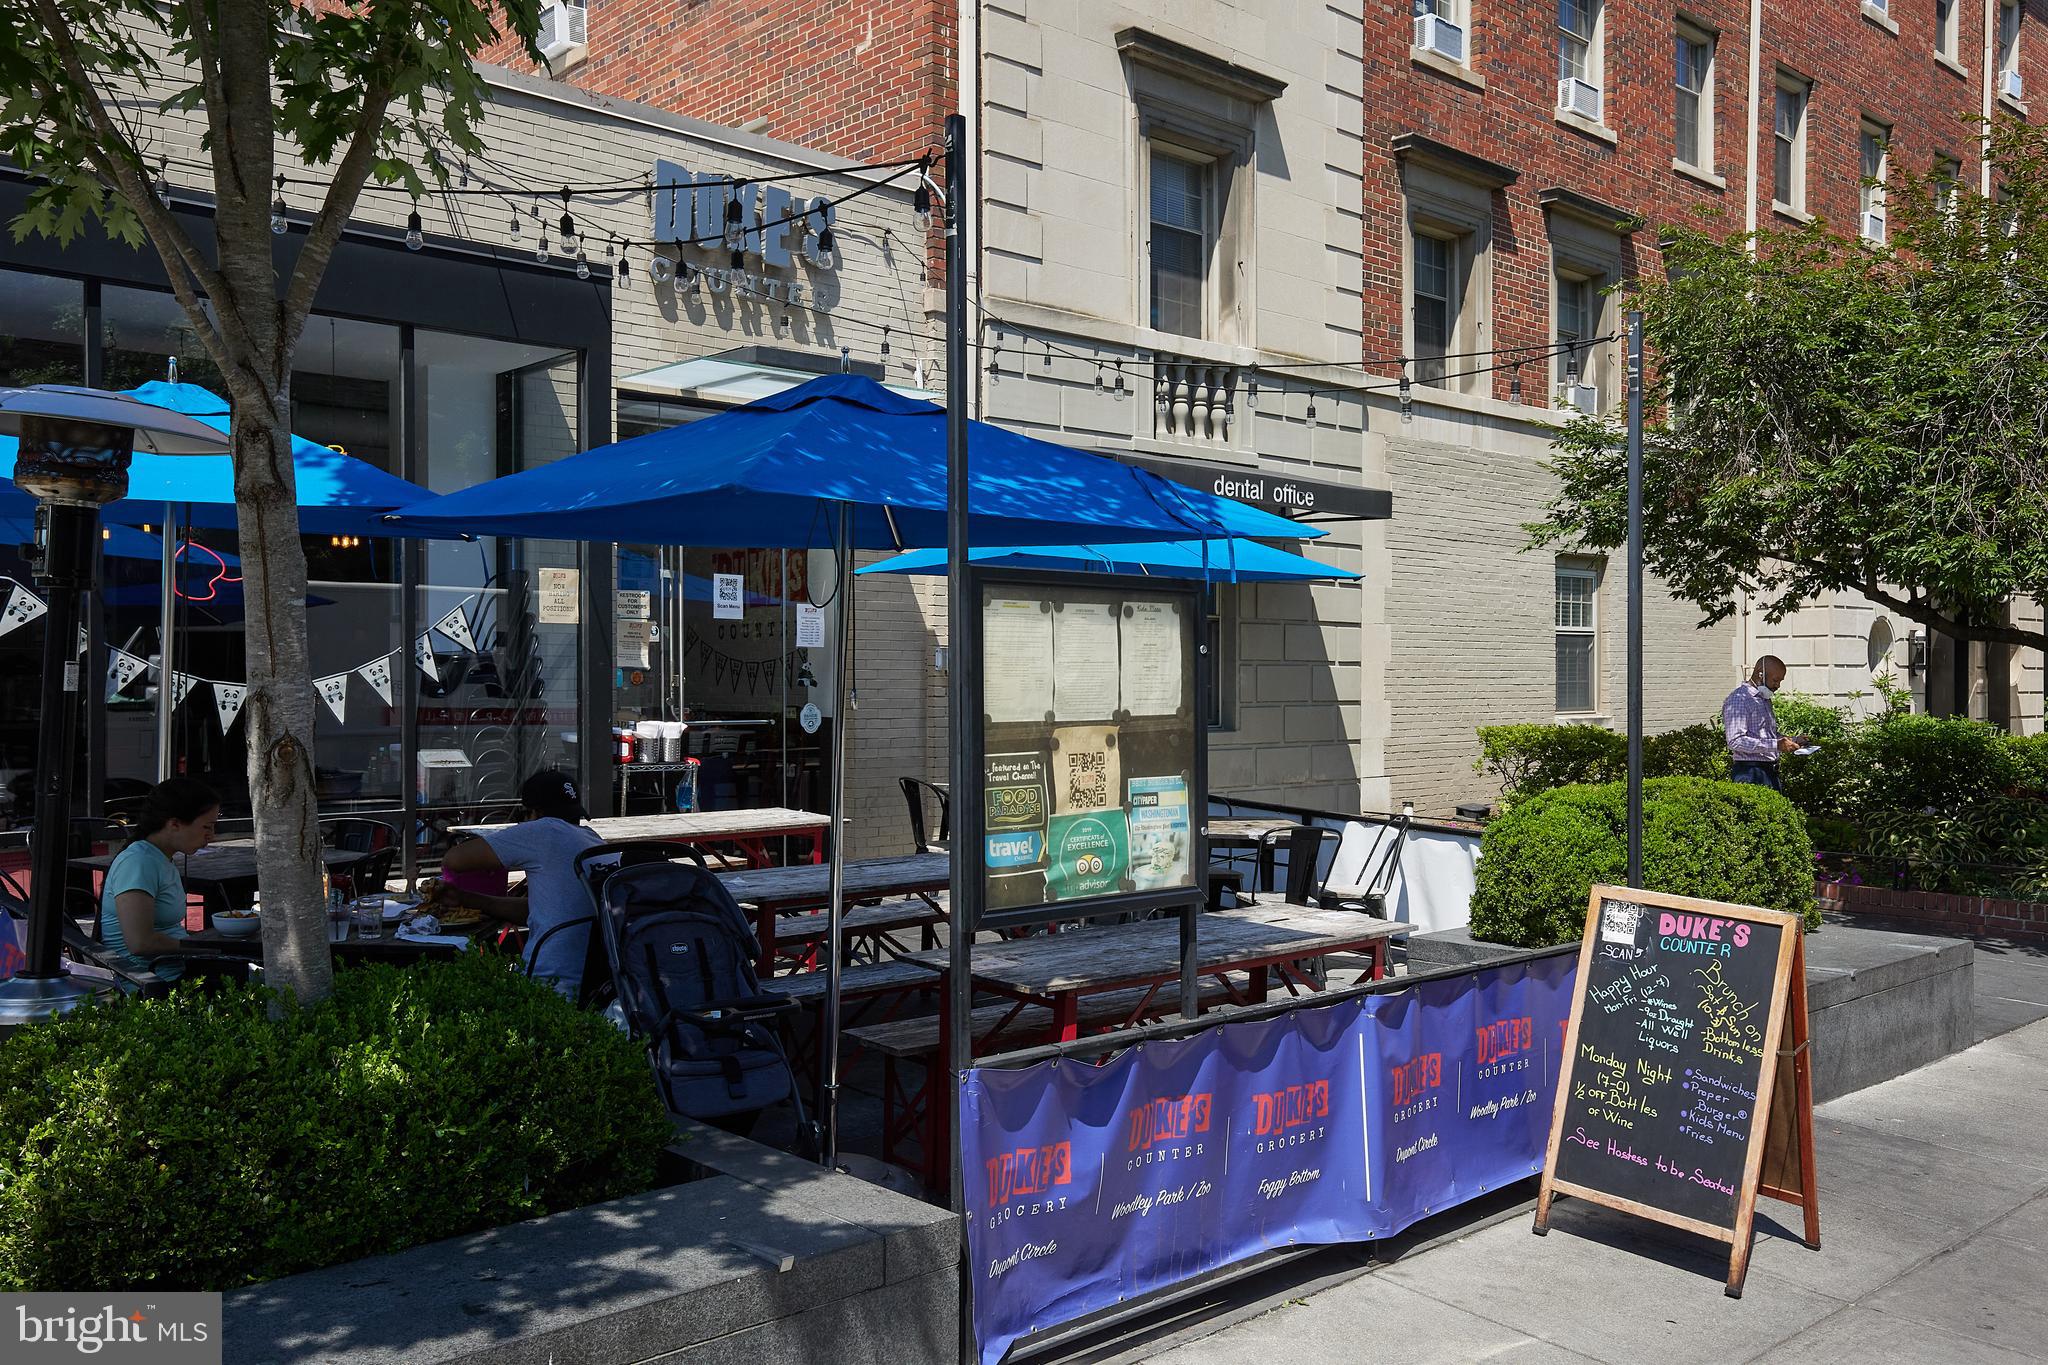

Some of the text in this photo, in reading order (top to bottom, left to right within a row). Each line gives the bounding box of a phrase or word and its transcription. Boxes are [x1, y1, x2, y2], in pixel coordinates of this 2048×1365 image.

[652, 159, 836, 270] DUKE'S
[1214, 475, 1314, 507] dental office
[987, 772, 1009, 782] Travel
[990, 802, 1041, 817] PARADISE
[992, 788, 1037, 806] FOOD
[989, 835, 1033, 857] travel
[1067, 840, 1109, 852] EXCELLENCE
[1070, 834, 1100, 843] CERTIFICATE
[1658, 912, 1752, 948] DUKE'S
[1599, 944, 1634, 960] SCAN
[1660, 936, 1731, 958] COUNTER
[1588, 964, 1658, 1004] Happy Hour
[1604, 974, 1670, 1014] Mon-Fri (12-7)
[1694, 958, 1761, 1042] Brunch on
[1697, 984, 1723, 1005] Sat
[1720, 1015, 1741, 1037] Sun
[1475, 1016, 1533, 1065] DUKE'S
[1638, 1030, 1679, 1053] Liquors
[1661, 1024, 1689, 1040] Well
[1581, 1043, 1673, 1085] Monday Night
[1702, 1041, 1744, 1064] Drinks
[1392, 1052, 1442, 1106] DUKE'S
[1478, 1058, 1530, 1080] COUNTER
[1692, 1068, 1757, 1101] Sandwiches
[1252, 1079, 1329, 1136] DUKE'S
[1470, 1099, 1499, 1120] Woodley
[1500, 1091, 1519, 1112] Park
[1526, 1089, 1537, 1103] Zoo
[1690, 1081, 1730, 1103] Proper
[1128, 1093, 1213, 1153] DUKE'S
[1394, 1096, 1439, 1124] GROCERY
[1602, 1108, 1634, 1130] Wine
[1688, 1109, 1745, 1142] Kids Menu
[1256, 1126, 1326, 1154] GROCERY
[1395, 1132, 1439, 1165] Dupont Circle
[1685, 1125, 1714, 1145] Fries
[1127, 1143, 1205, 1172] COUNTER
[1566, 1126, 1736, 1197] See Hostess to be Seated
[986, 1140, 1072, 1209] DUKE'S
[1257, 1167, 1321, 1200] Foggy Bottom
[989, 1196, 1067, 1230] GROCERY
[1111, 1193, 1153, 1221] Woodley
[1155, 1184, 1185, 1207] Park
[1196, 1179, 1212, 1199] Zoo
[988, 1239, 1058, 1279] Dupont Circle
